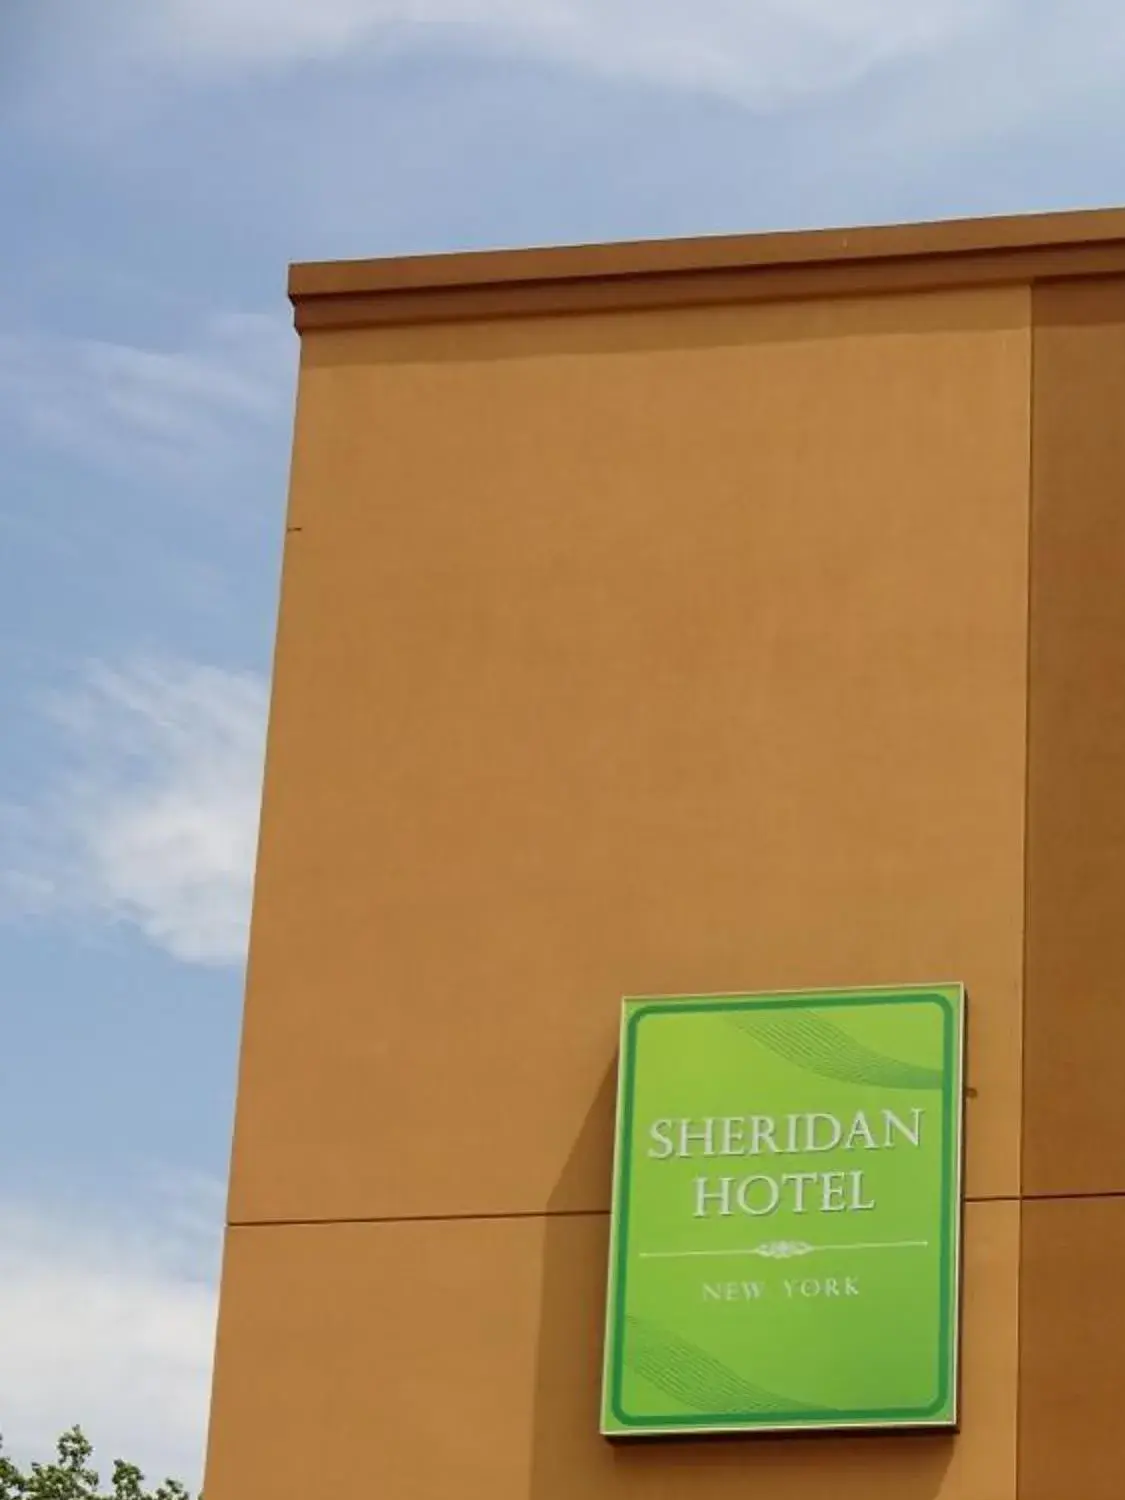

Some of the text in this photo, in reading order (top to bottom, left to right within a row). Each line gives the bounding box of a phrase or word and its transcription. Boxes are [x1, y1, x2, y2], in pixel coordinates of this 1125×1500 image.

[647, 1108, 925, 1159] SHERIDAN
[692, 1171, 876, 1217] HOTEL
[702, 1276, 860, 1302] NEW YORK
